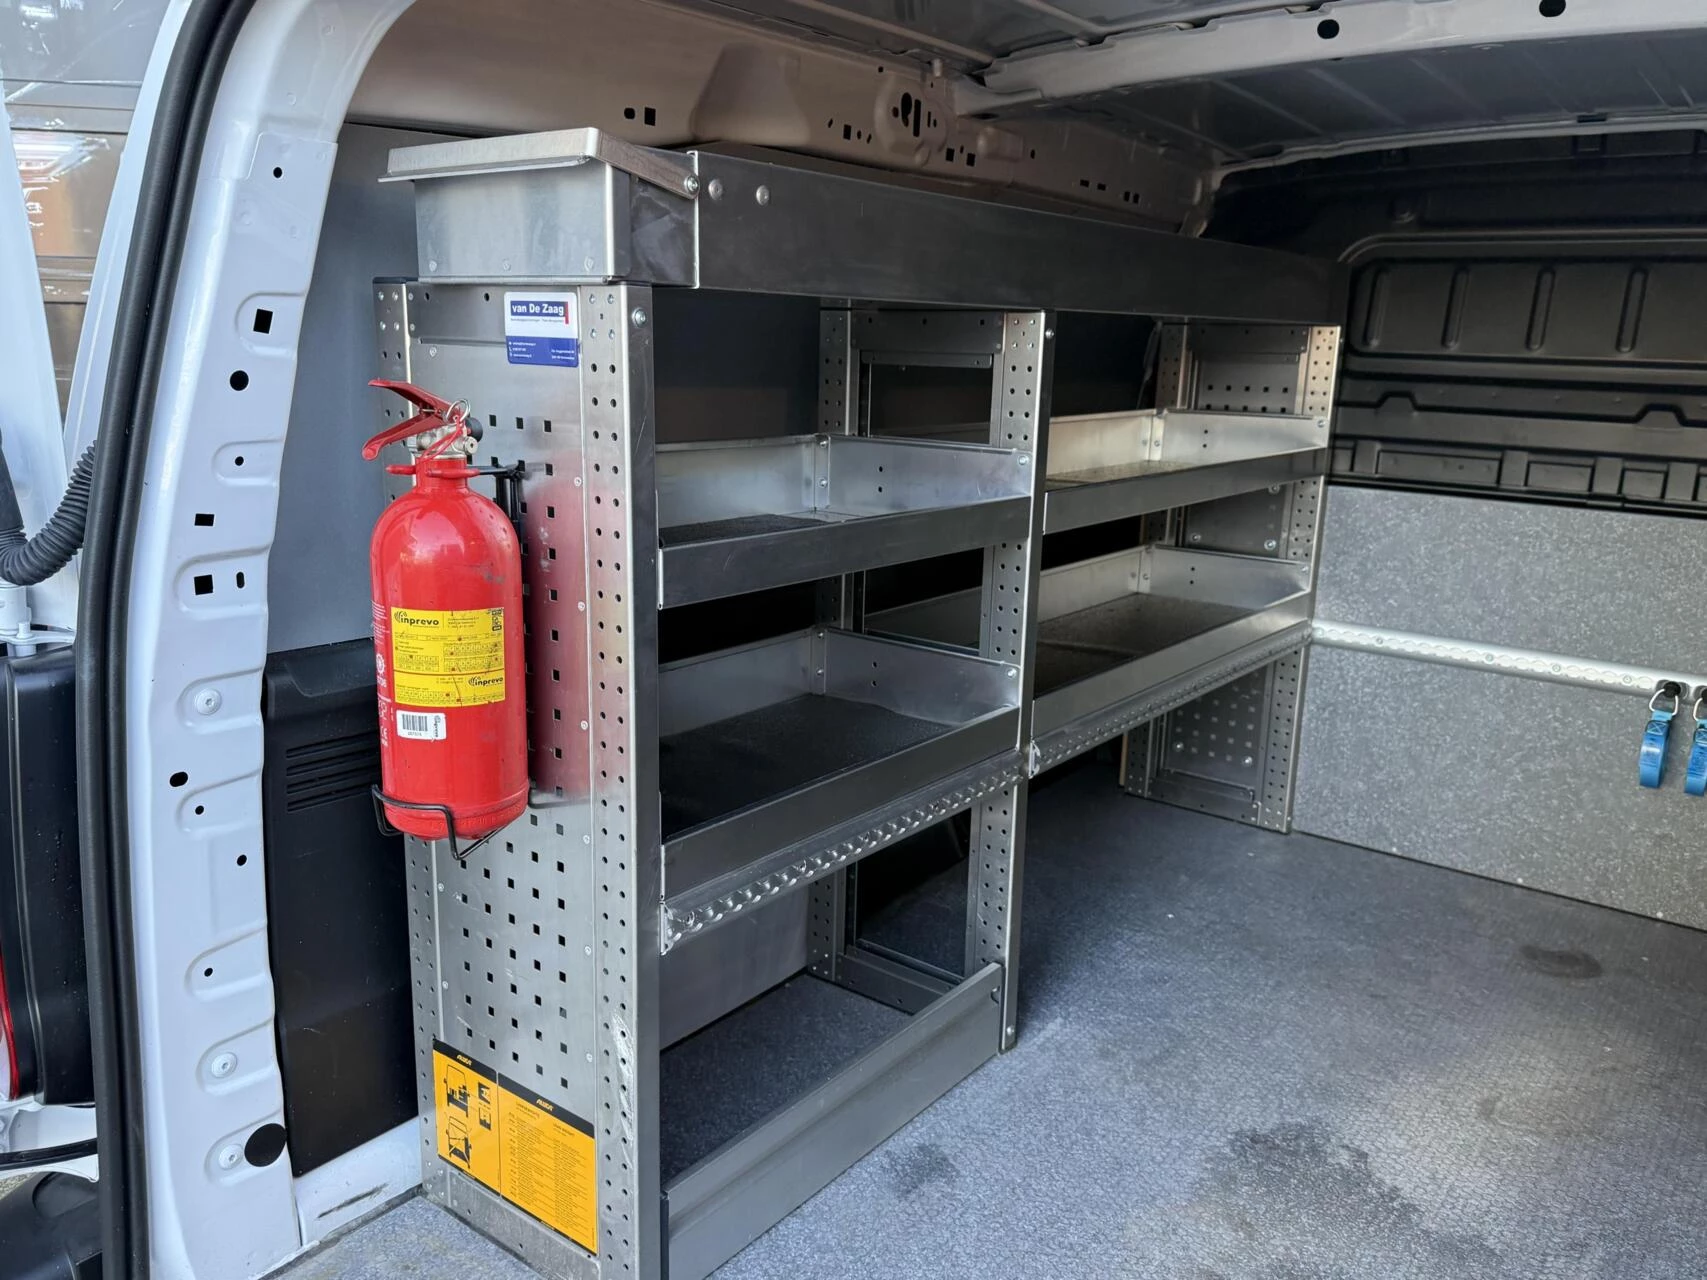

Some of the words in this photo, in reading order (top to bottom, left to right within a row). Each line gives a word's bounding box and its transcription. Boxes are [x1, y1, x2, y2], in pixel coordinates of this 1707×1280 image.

[511, 304, 527, 313] van
[529, 303, 540, 313] De
[542, 303, 564, 316] Zaag
[400, 614, 439, 626] inprevo
[474, 676, 503, 686] inprevo
